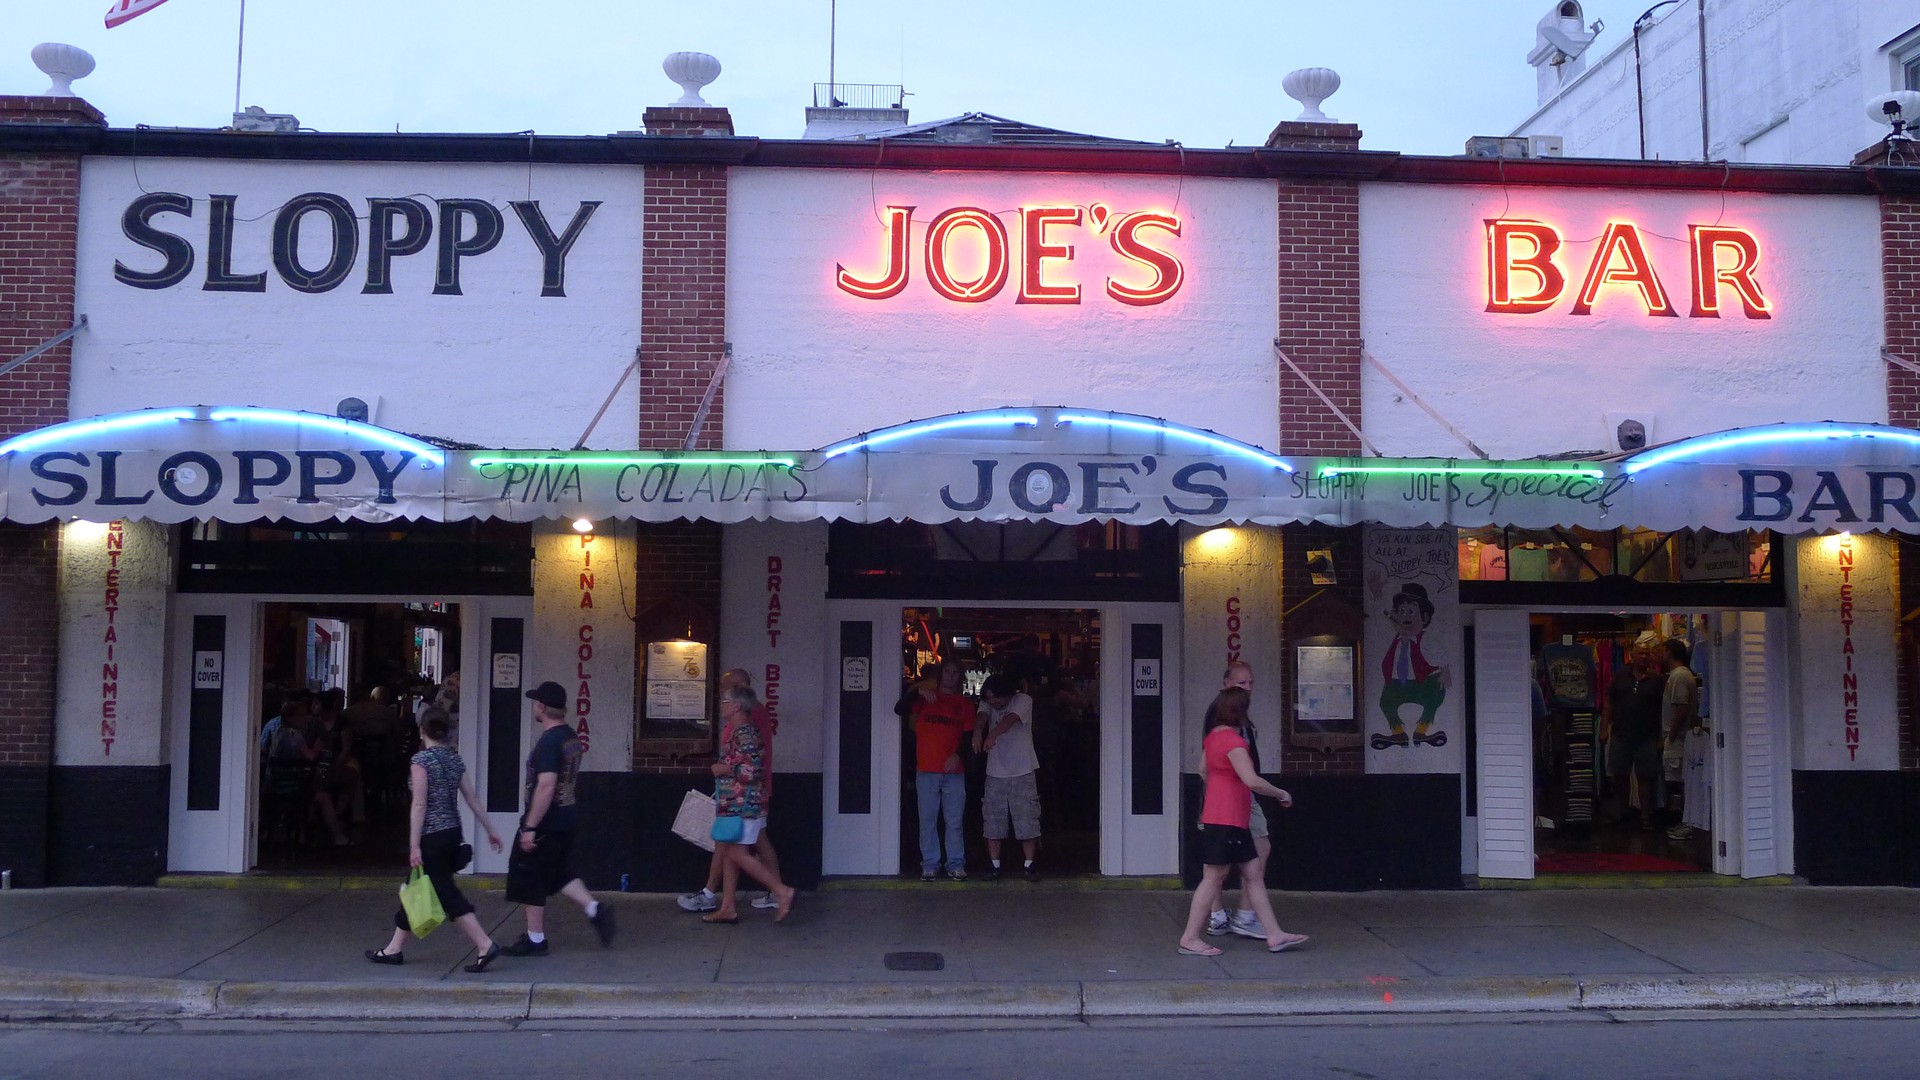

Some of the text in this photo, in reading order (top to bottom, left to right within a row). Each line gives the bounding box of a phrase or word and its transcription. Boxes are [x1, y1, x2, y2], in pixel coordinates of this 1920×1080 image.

[114, 192, 1773, 320] SLOPPY JOE'S BAR
[30, 450, 417, 506] SLOPPY
[939, 456, 1229, 514] JOE'S
[1290, 471, 1370, 500] SLOPPY
[1466, 463, 1629, 515] Special
[1736, 470, 1920, 523] BAR
[1391, 555, 1422, 573] SLOPPY
[1415, 534, 1431, 544] SEE
[101, 520, 123, 756] ENTERTAINMENT
[204, 657, 214, 668] NO
[765, 555, 782, 735] DRAFT BEER
[197, 671, 220, 681] COVER
[576, 624, 593, 752] COLADAS
[1135, 679, 1159, 689] COVER
[1141, 665, 1152, 675] NO
